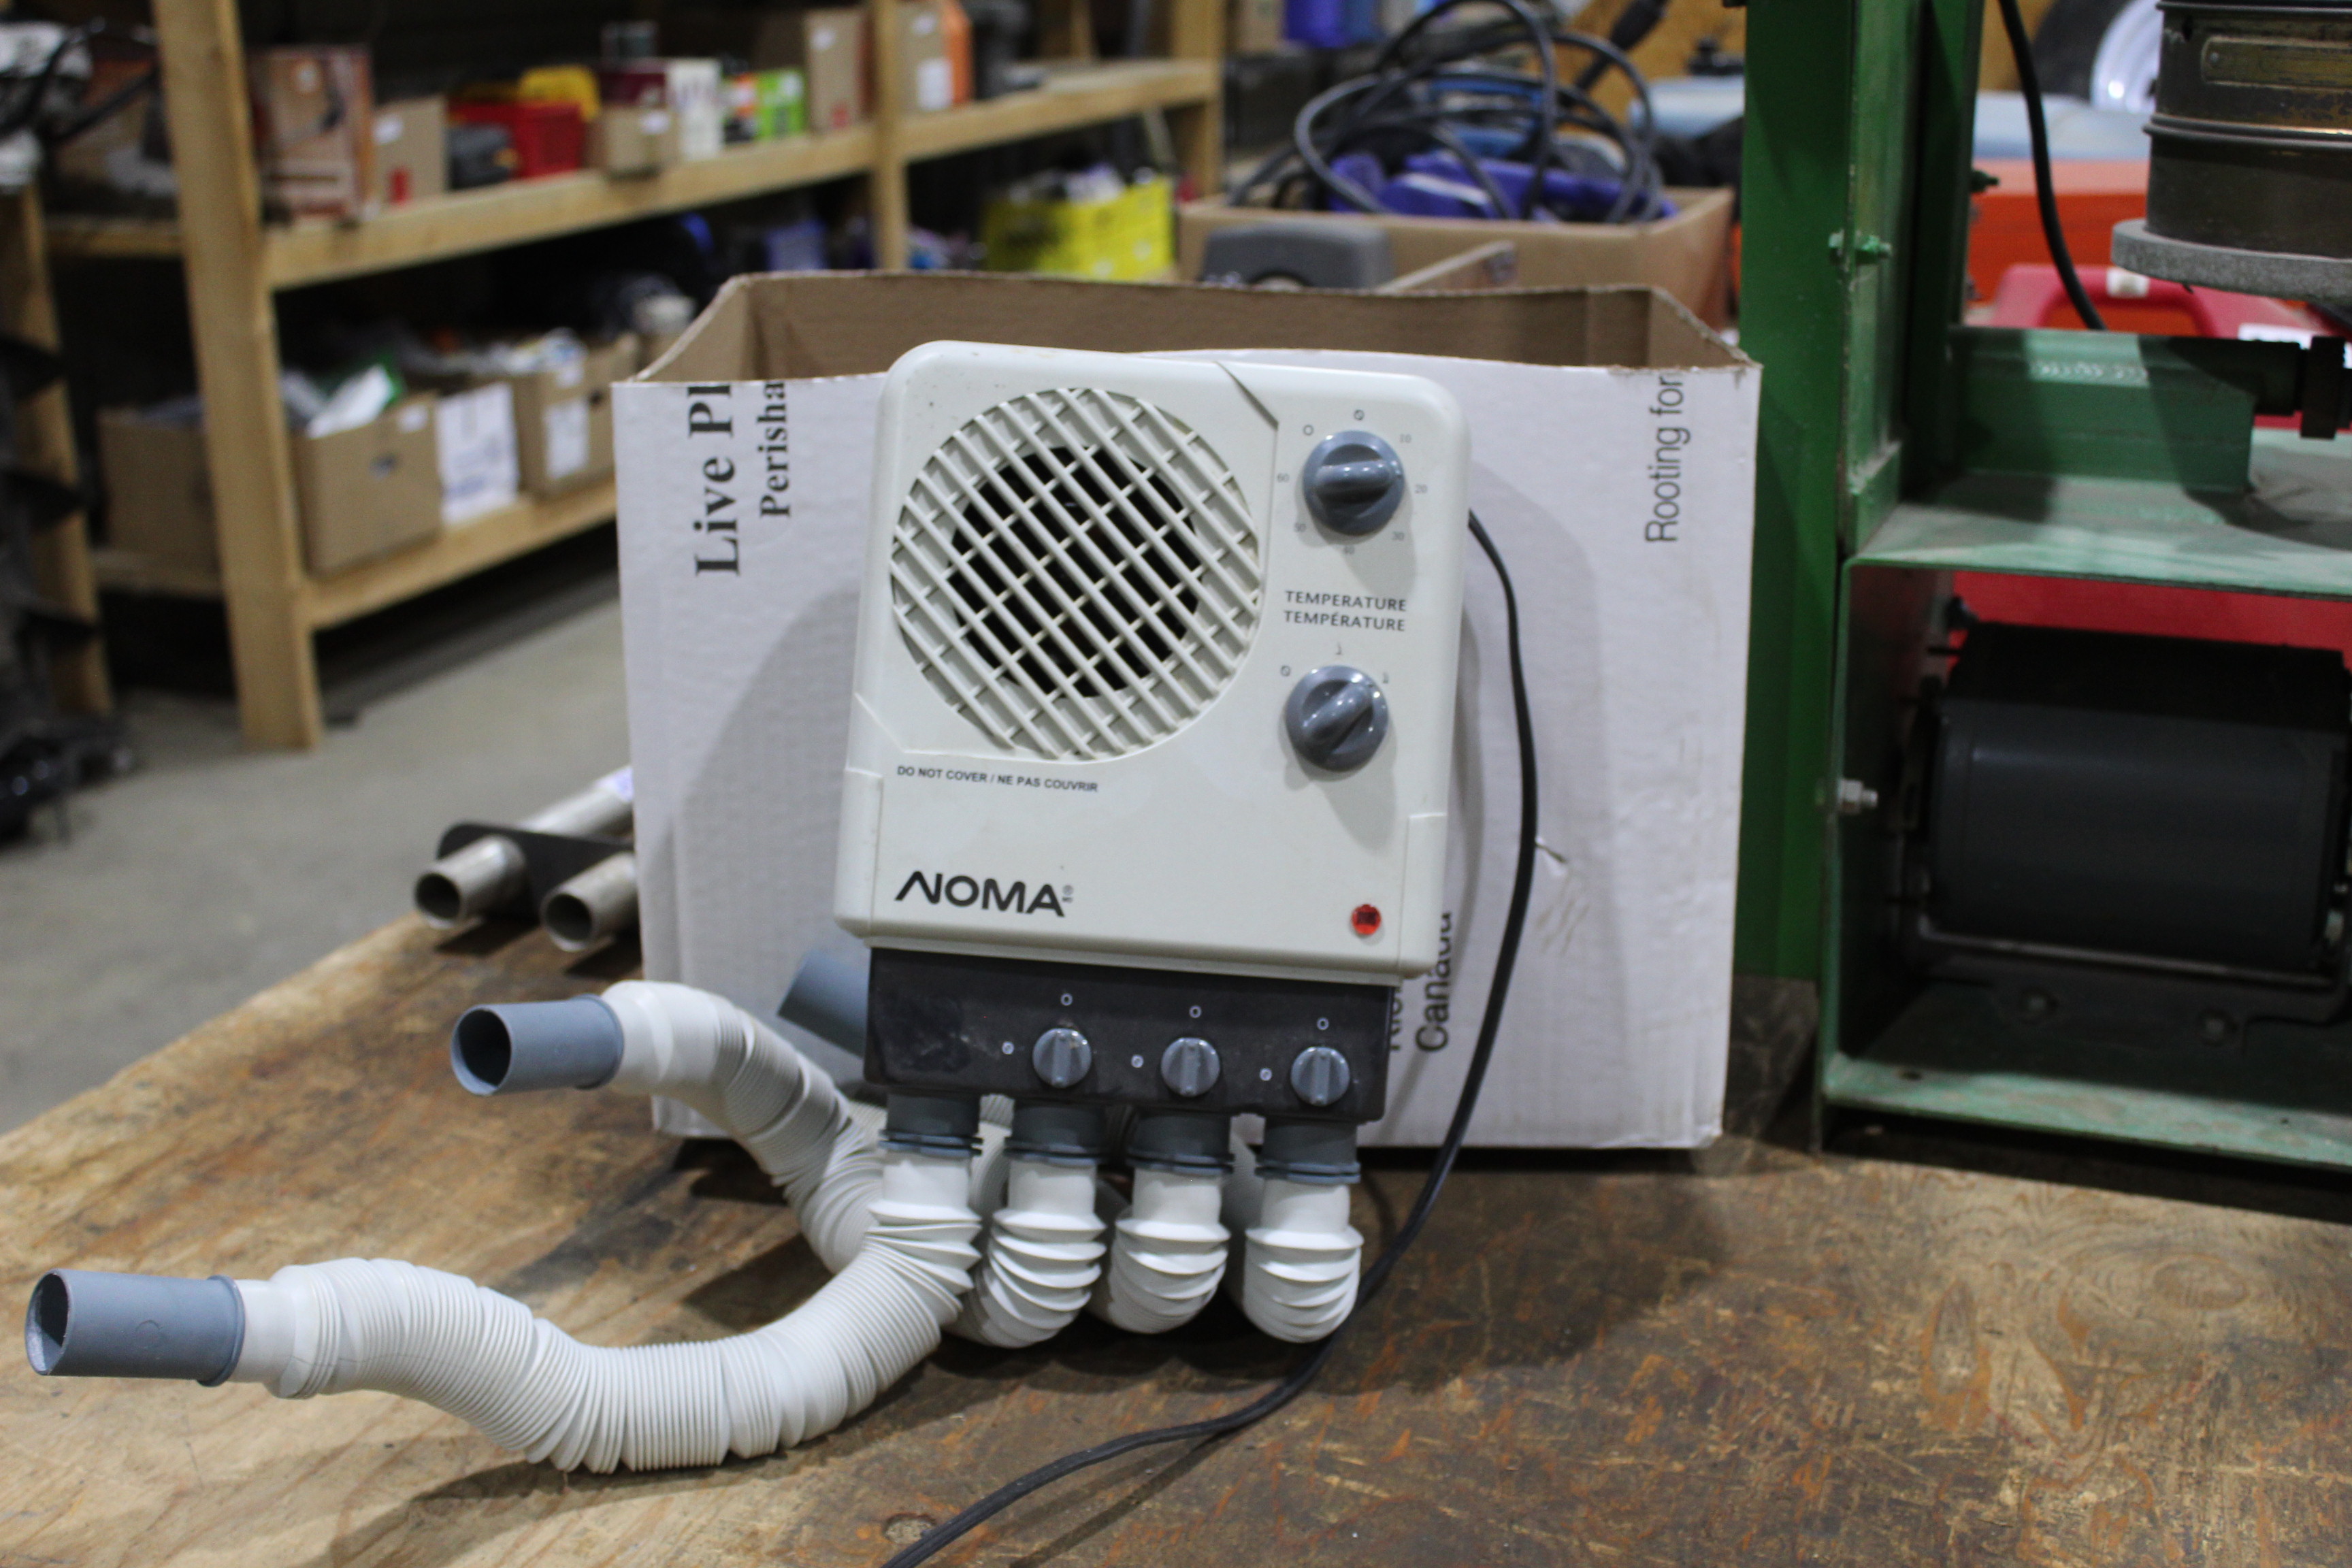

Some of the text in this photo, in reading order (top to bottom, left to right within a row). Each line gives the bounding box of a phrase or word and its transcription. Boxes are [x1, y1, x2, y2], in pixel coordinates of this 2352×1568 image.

[756, 381, 791, 518] Perisha
[1399, 434, 1412, 444] 10
[1645, 376, 1691, 542] Rooting for
[1415, 484, 1428, 494] 20
[695, 457, 740, 576] Live
[1285, 590, 1407, 612] TEMPERATURE
[1284, 609, 1405, 632] TEMPÉRATURE
[897, 765, 915, 777] DO
[918, 767, 943, 779] NOT
[946, 770, 987, 783] COVER
[998, 774, 1013, 785] NE
[1017, 777, 1041, 787] PAS
[1044, 779, 1098, 792] COUVRIR
[894, 870, 1064, 917] NOMA
